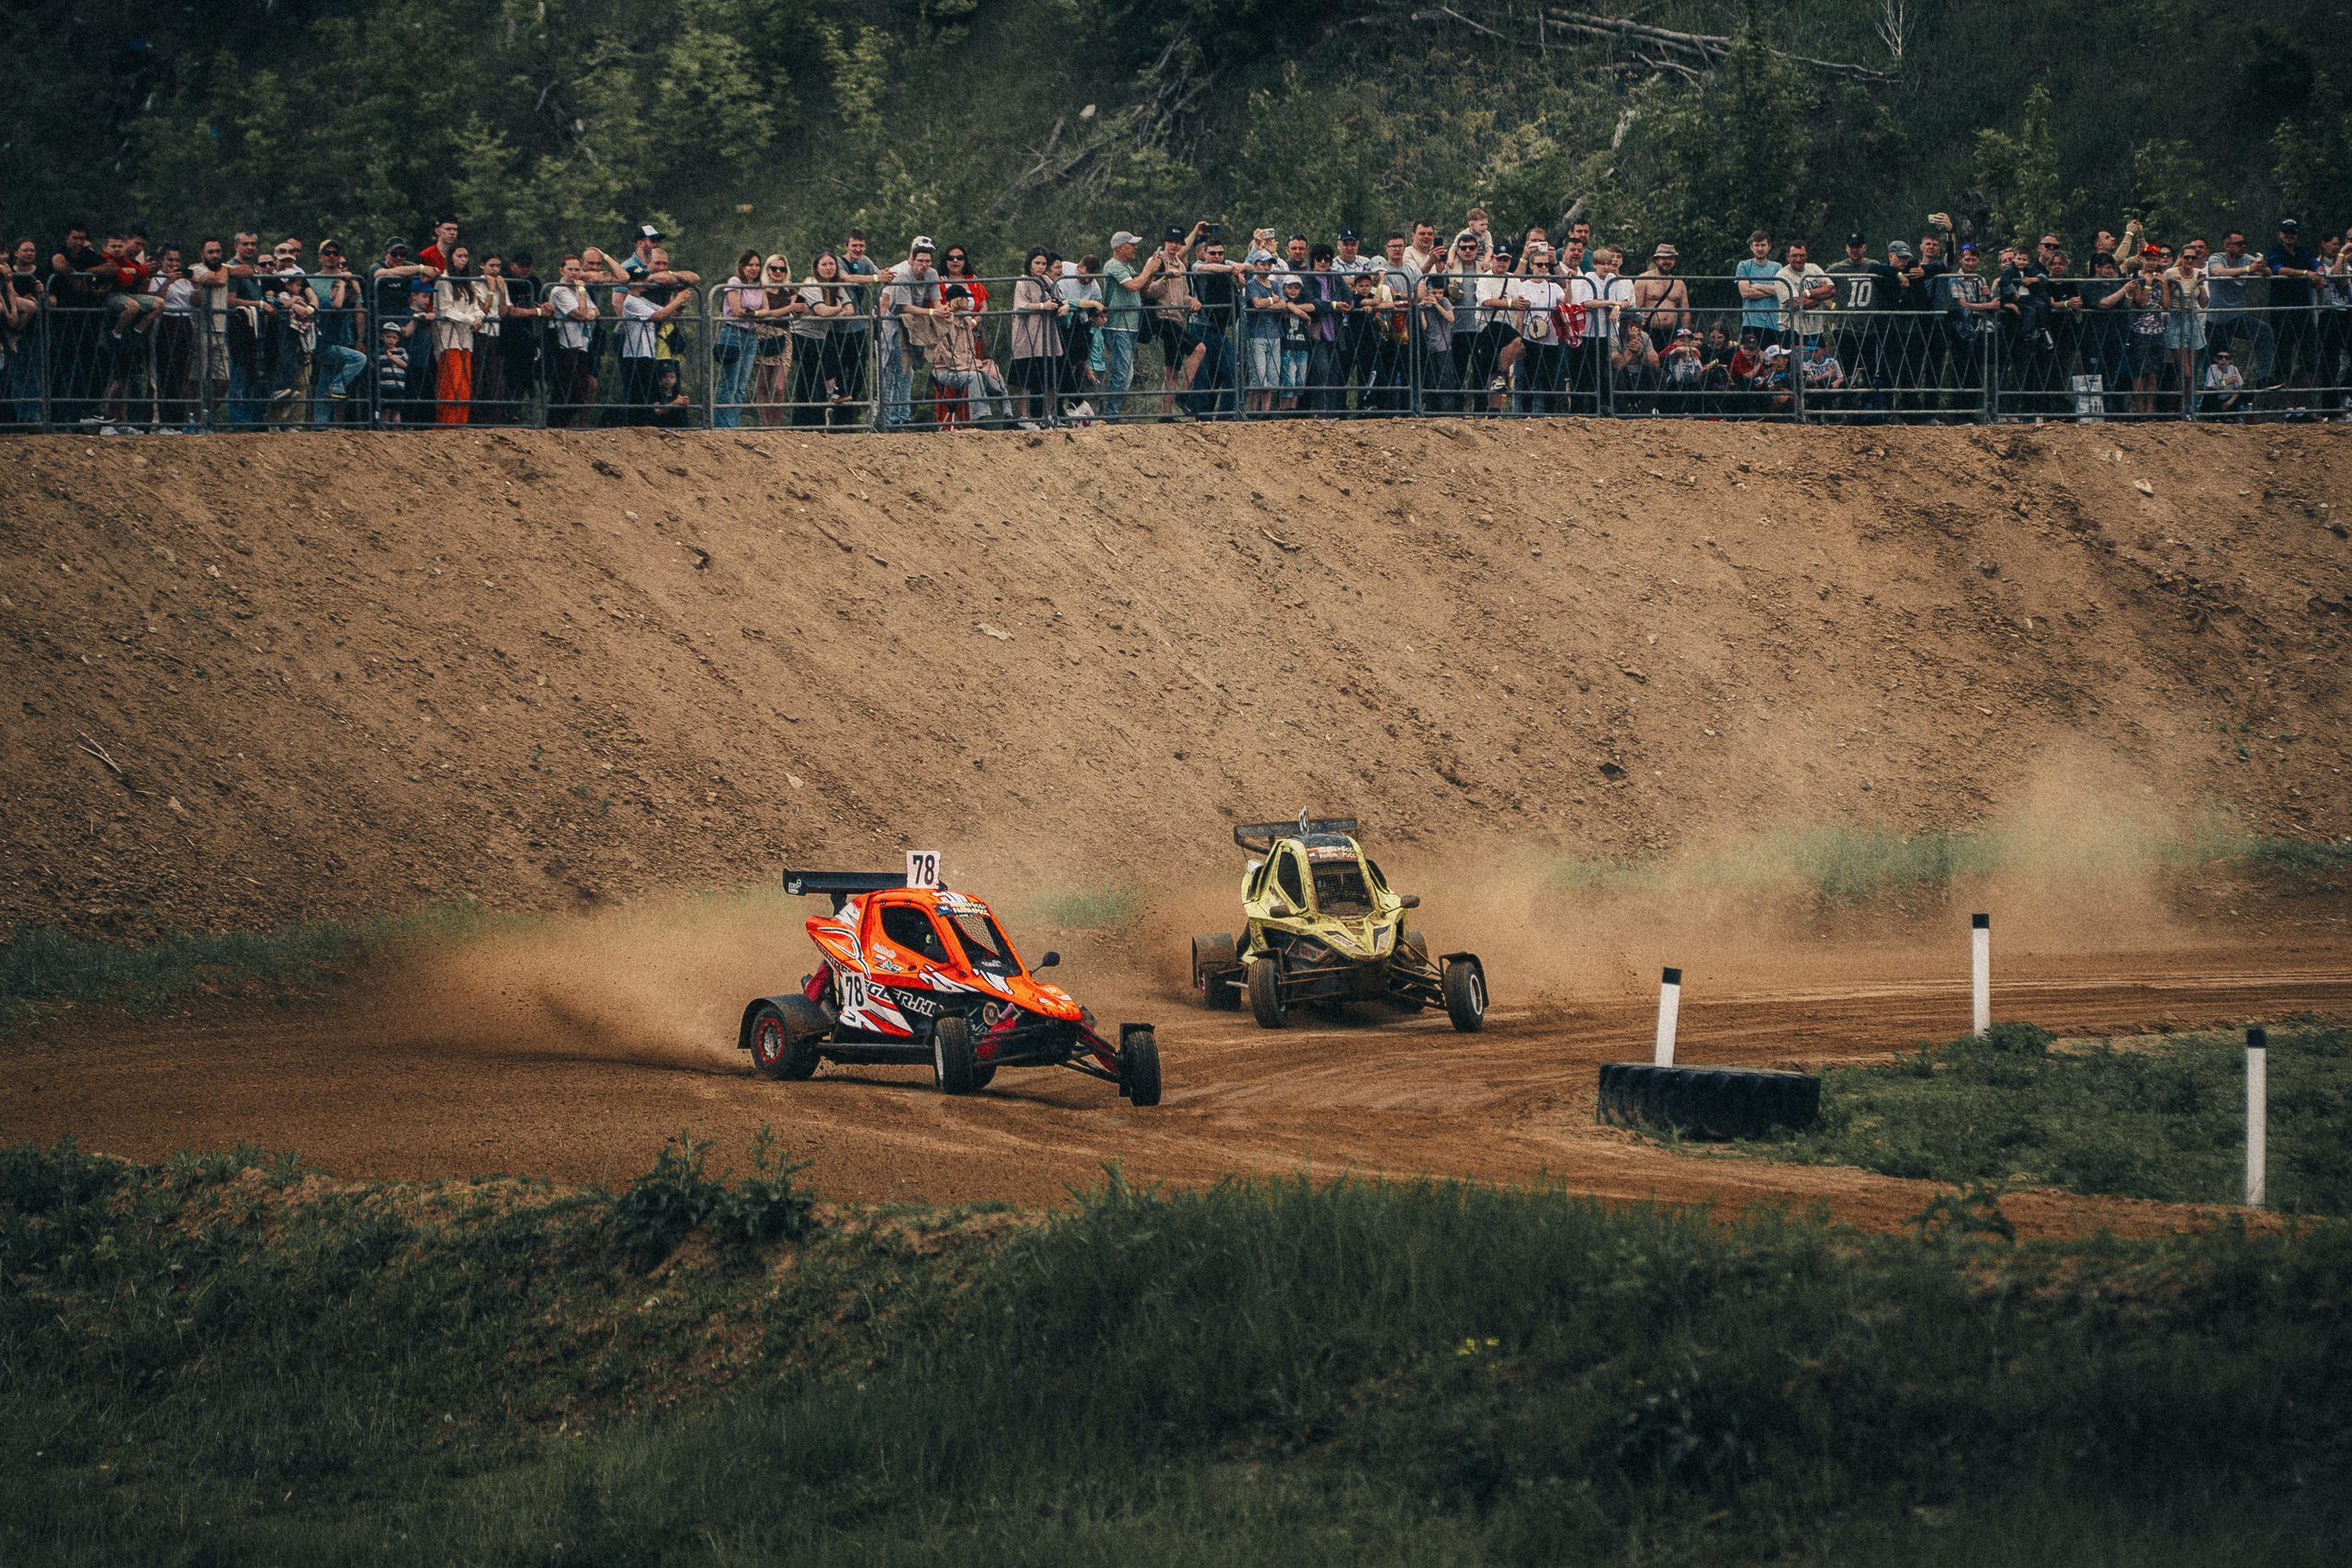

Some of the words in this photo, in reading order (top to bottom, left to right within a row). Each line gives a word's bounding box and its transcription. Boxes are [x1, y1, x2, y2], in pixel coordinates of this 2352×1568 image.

[1847, 281, 1872, 307] 10
[912, 854, 935, 886] 78
[845, 976, 865, 1007] 78
